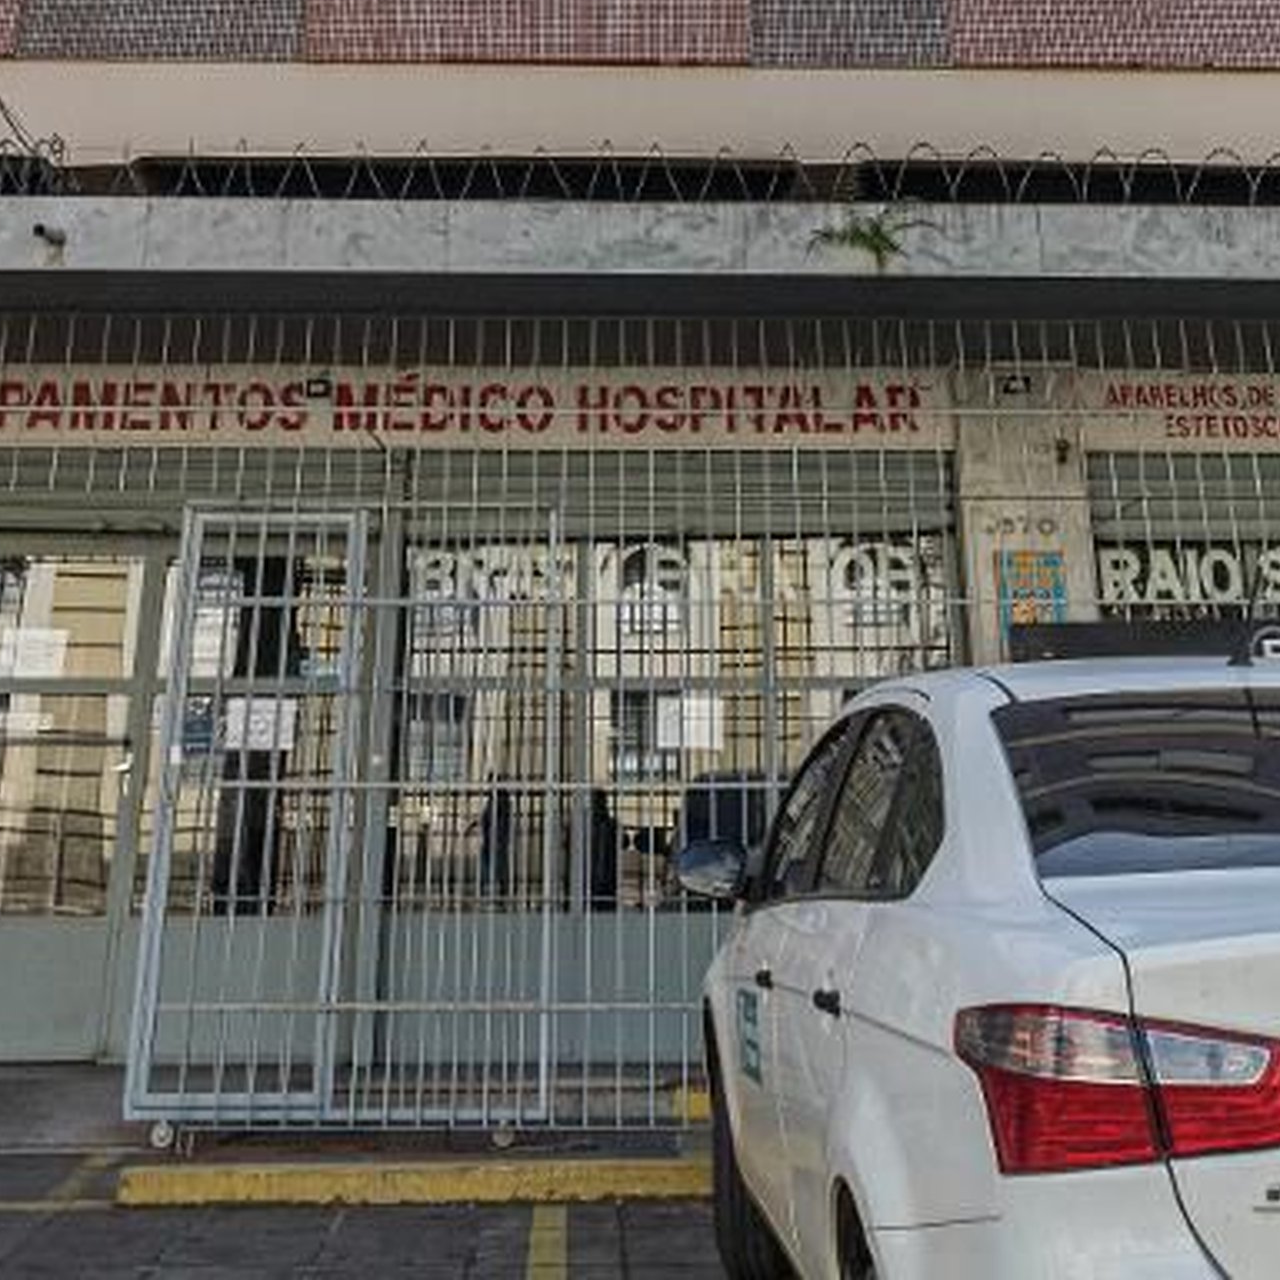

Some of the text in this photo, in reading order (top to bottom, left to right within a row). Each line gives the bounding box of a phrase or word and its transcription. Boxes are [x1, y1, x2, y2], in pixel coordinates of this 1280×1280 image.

[331, 371, 554, 433] MÉDICO
[576, 382, 920, 434] HOSPITALAR
[1249, 384, 1275, 408] DE
